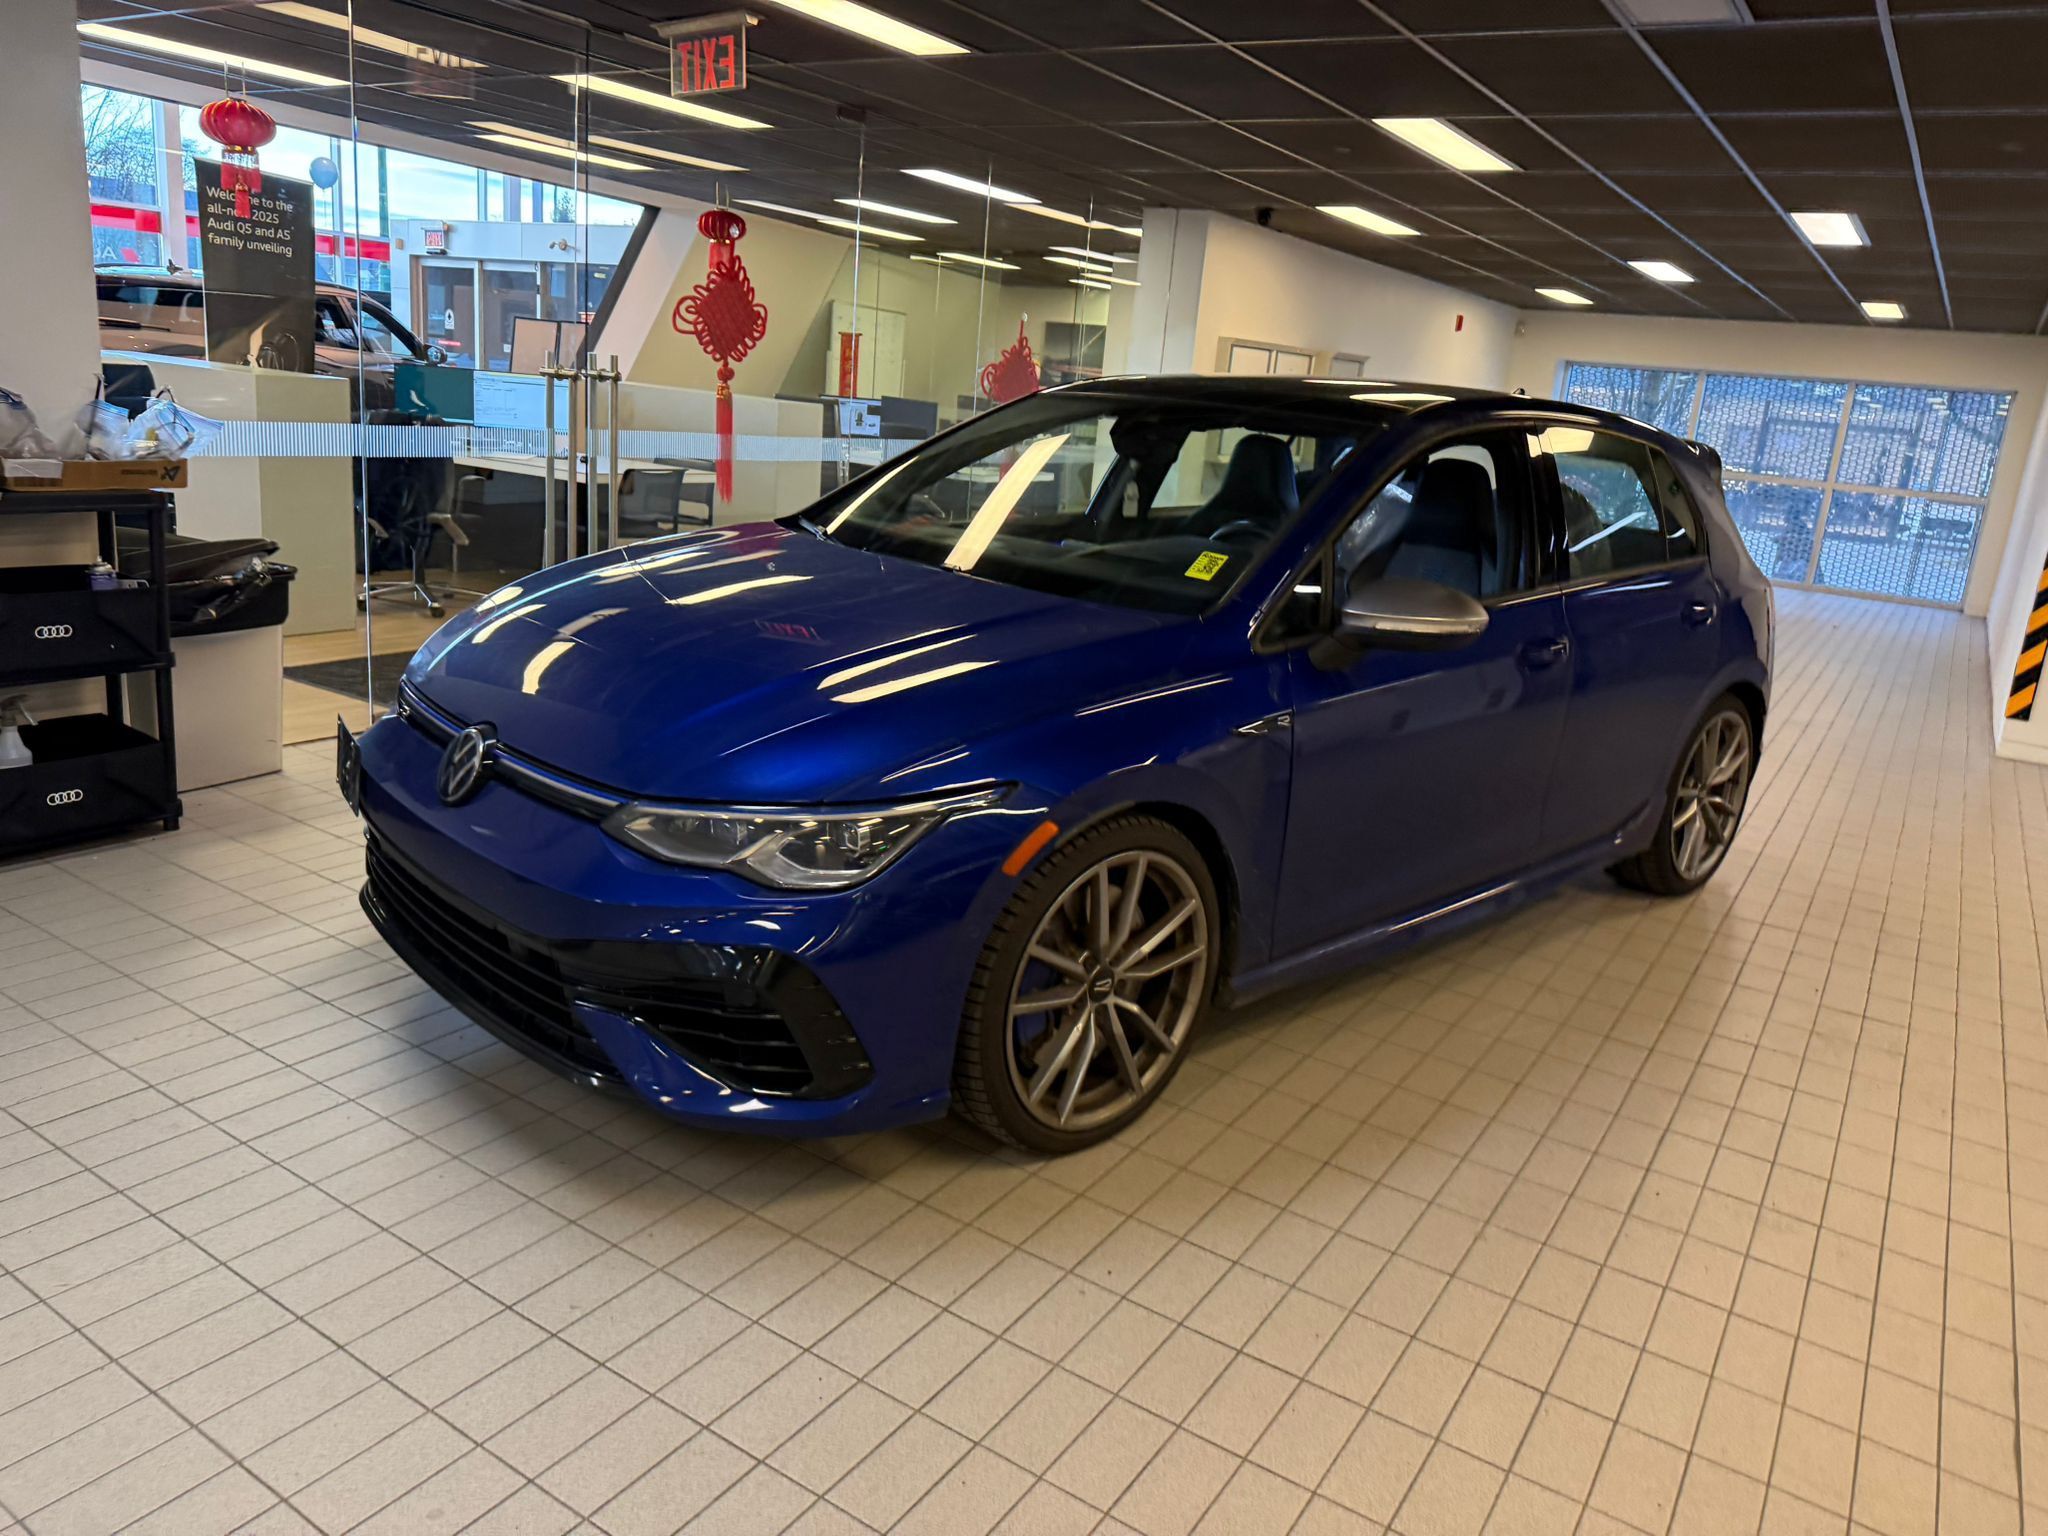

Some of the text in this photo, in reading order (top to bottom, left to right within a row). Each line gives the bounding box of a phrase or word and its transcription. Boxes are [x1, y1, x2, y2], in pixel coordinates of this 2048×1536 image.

[262, 197, 273, 209] to
[276, 200, 293, 212] the
[252, 209, 279, 224] 2025
[207, 217, 291, 240] Audi Q5 and A5
[208, 233, 293, 258] family unveiling
